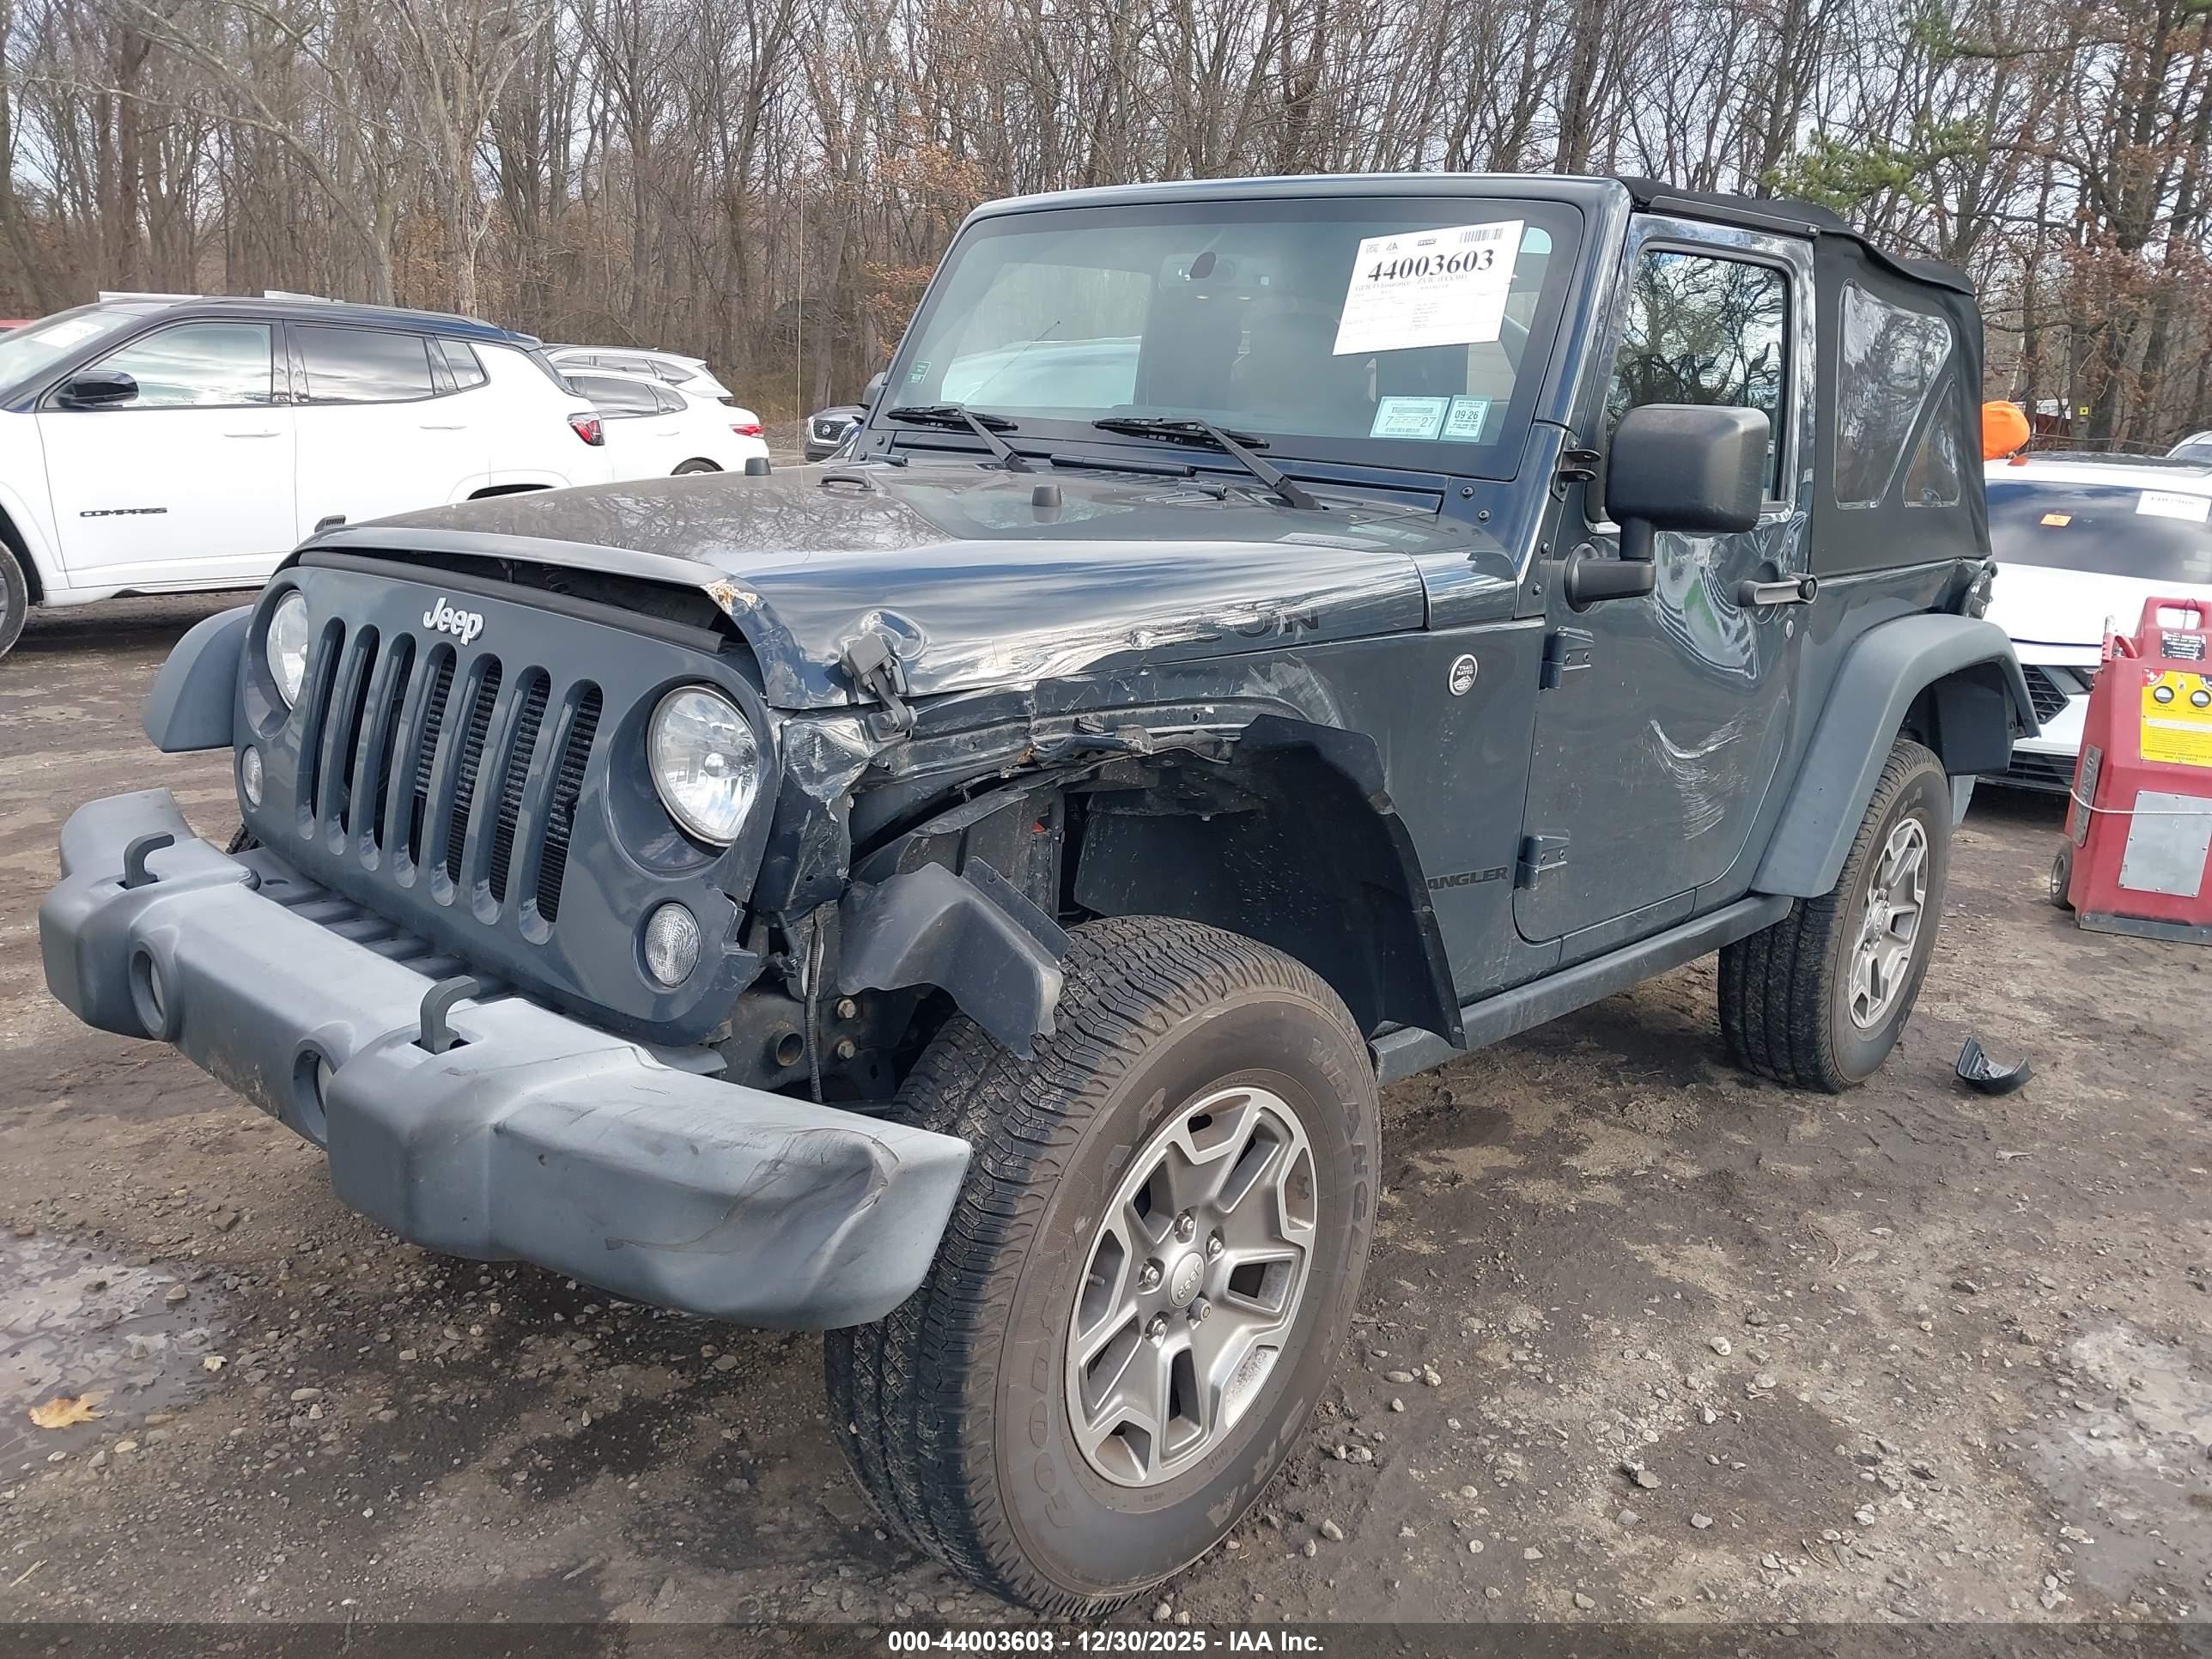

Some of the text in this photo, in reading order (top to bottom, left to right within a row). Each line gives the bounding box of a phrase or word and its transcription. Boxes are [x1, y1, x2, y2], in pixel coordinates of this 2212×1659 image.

[1368, 249, 1494, 282] 44003603
[80, 507, 167, 517] COMPASS
[423, 598, 483, 646] Jeep
[1427, 866, 1509, 890] ANGLER
